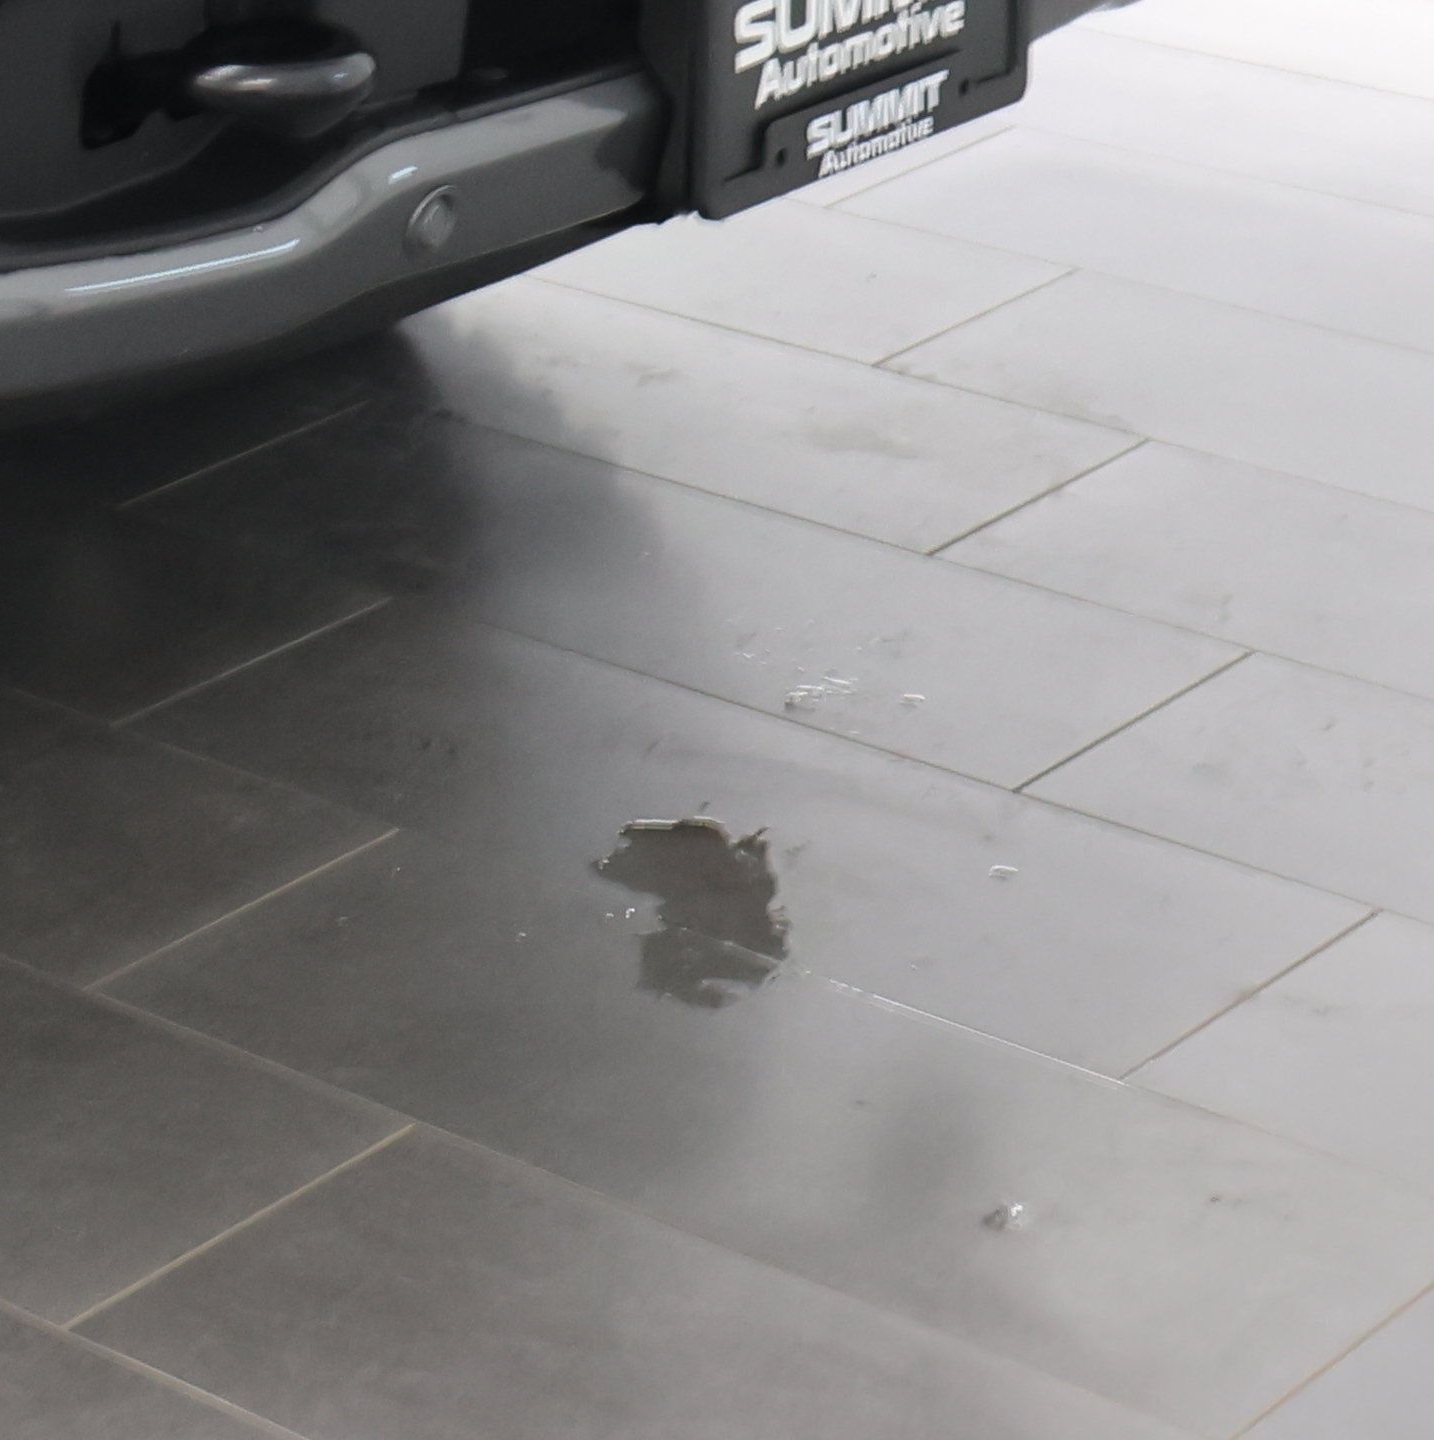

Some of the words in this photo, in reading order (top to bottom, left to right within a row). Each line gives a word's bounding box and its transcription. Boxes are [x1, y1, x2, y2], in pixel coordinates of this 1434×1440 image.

[754, 0, 965, 110] Automotive
[806, 70, 950, 161] SUMMIT
[817, 115, 935, 178] Automotive
